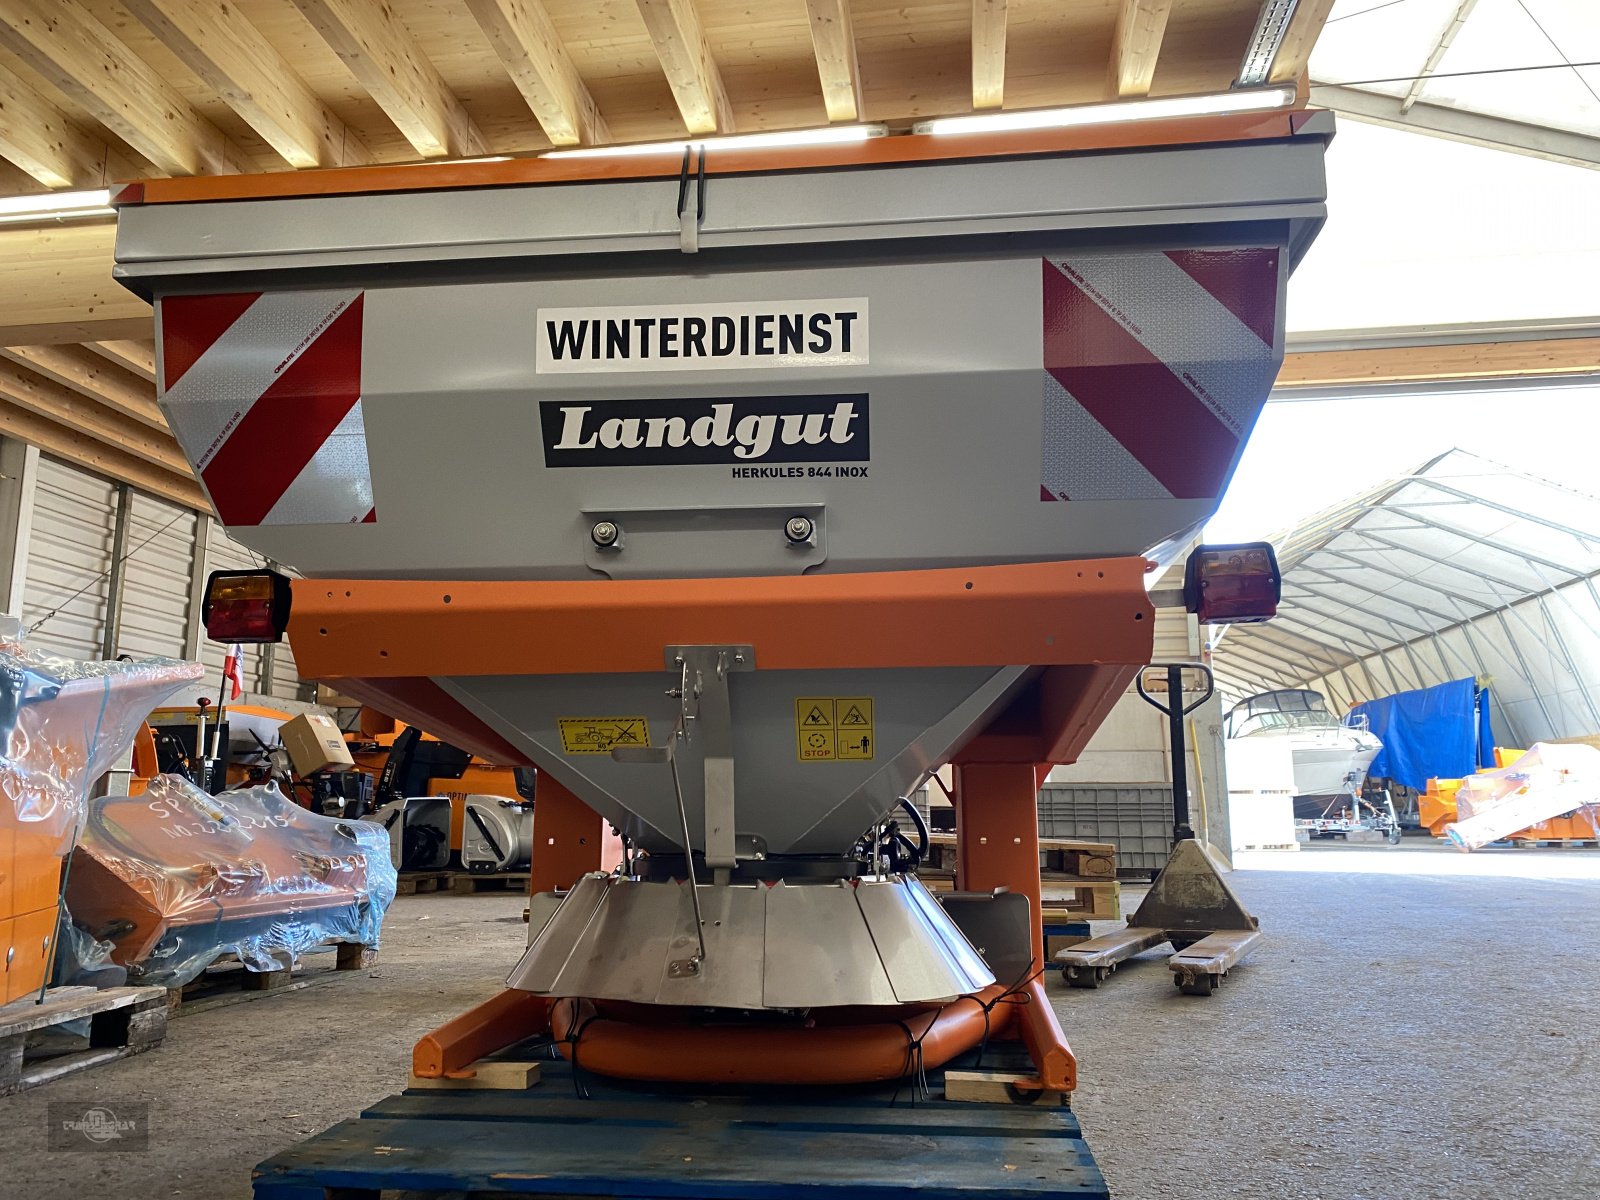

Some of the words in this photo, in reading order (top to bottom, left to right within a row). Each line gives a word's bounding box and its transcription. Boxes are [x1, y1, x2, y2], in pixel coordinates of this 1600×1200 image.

[546, 312, 858, 360] WINTERDIENST
[553, 402, 858, 458] Landgut
[732, 467, 805, 478] HERKULES
[807, 467, 832, 477] 844
[835, 467, 868, 477] INOX
